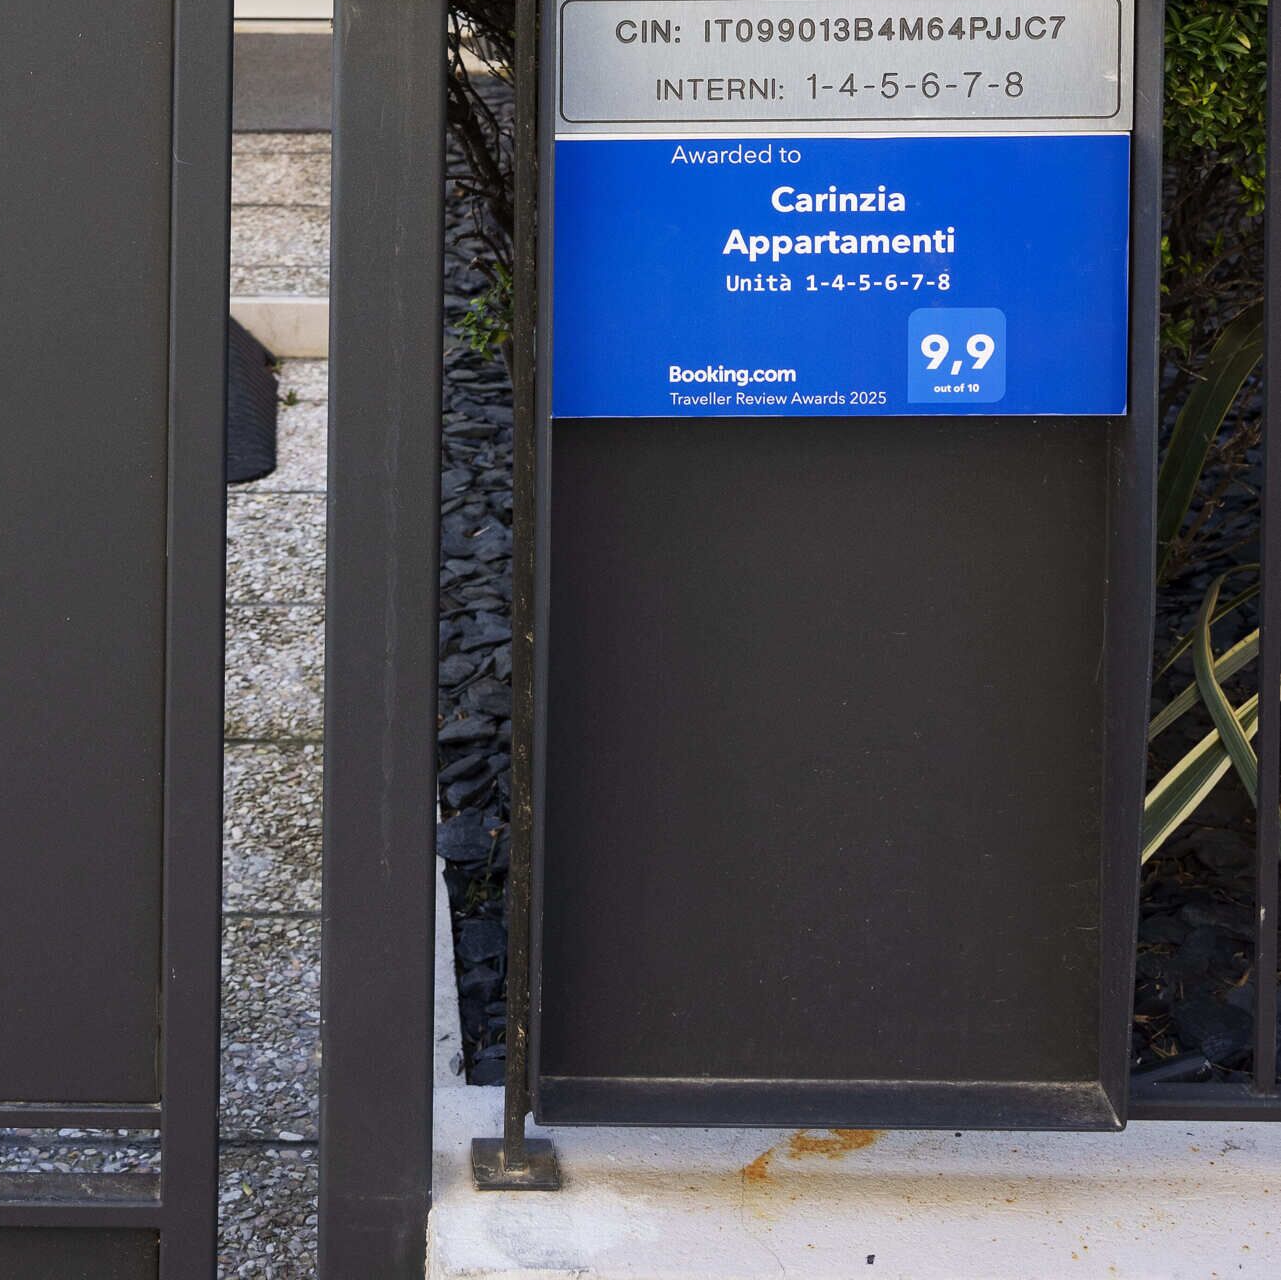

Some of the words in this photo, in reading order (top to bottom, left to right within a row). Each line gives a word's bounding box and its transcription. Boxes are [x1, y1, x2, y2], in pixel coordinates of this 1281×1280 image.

[616, 20, 680, 43] CIN:
[705, 16, 1065, 42] IT099013B4M64PJJC7
[657, 78, 783, 100] INTERNI:
[807, 72, 1023, 99] 1-4-5-6-7-8
[672, 144, 771, 163] Awarded
[779, 148, 801, 163] to
[772, 185, 905, 212] Carinzia
[723, 227, 954, 262] Appartamenti
[727, 274, 791, 291] Unità
[807, 274, 950, 291] 1-4-5-6-7-8
[921, 334, 994, 375] 9,9
[670, 365, 796, 386] Booking.com
[670, 392, 732, 405] Traveller
[736, 392, 787, 404] Review
[791, 392, 845, 404] Awards
[850, 392, 886, 404] 2025
[934, 384, 951, 393] out
[954, 383, 964, 393] of
[968, 383, 979, 393] 10
